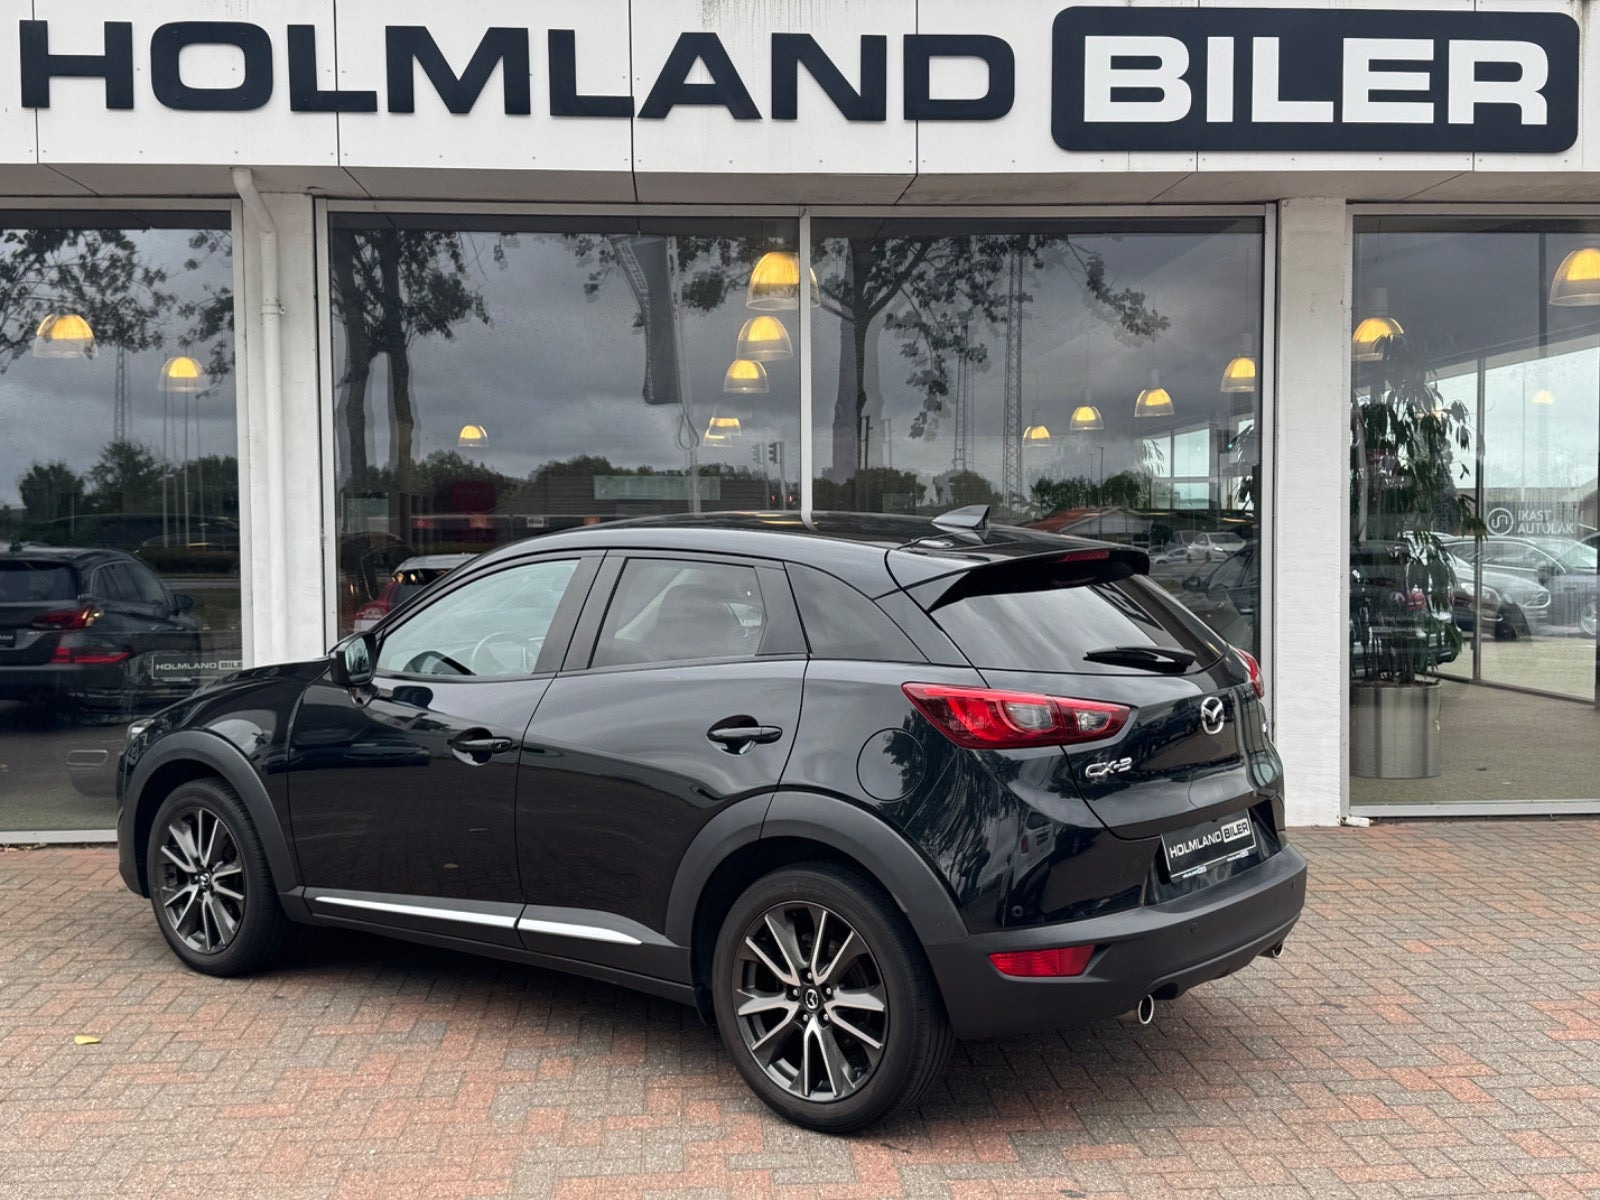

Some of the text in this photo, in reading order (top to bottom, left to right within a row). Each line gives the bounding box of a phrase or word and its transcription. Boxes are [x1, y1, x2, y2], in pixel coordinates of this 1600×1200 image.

[20, 20, 1549, 127] HOLMLAND BILER
[1517, 509, 1574, 534] IKAST AUTOLAK
[156, 662, 217, 671] HOLMLAND
[1085, 756, 1133, 778] CX-3
[1169, 831, 1222, 858] HOLMLAND
[1224, 821, 1249, 840] BILER
